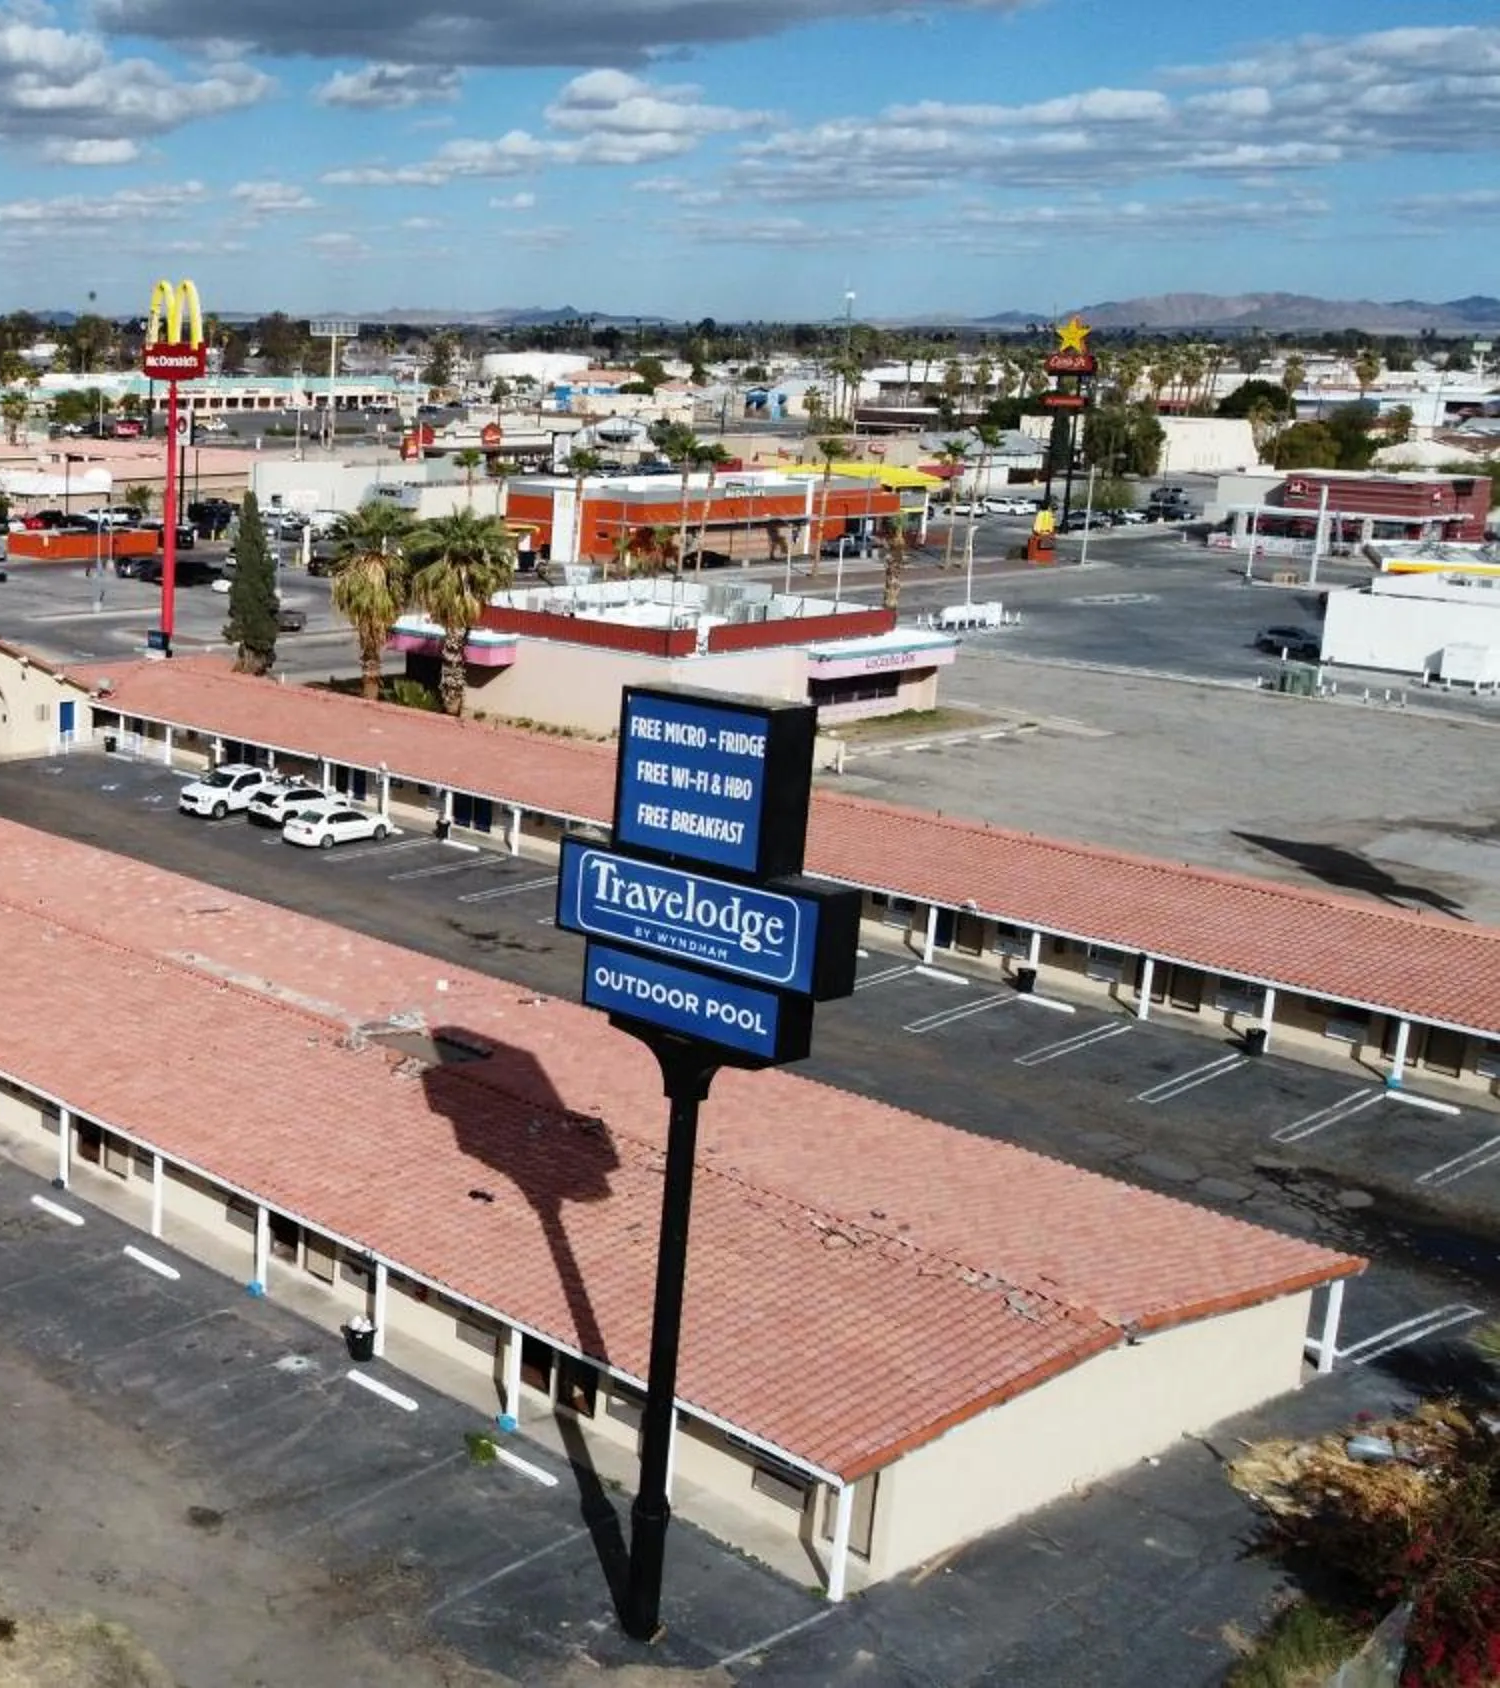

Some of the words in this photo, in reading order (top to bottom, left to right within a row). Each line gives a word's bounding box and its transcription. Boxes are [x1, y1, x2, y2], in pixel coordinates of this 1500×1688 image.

[630, 715, 663, 741] FREE
[664, 722, 707, 749] MICRO
[718, 730, 766, 758] FRIDGE
[637, 760, 669, 786] FREE
[671, 765, 709, 793] WI-FI
[711, 773, 721, 795] &
[723, 776, 753, 800] HBO
[637, 803, 669, 830] FREE
[670, 809, 745, 845] BREAKFAST
[591, 858, 785, 953] Travelodge
[634, 926, 651, 938] BY
[657, 931, 728, 960] WYNDHAM
[595, 967, 699, 1015] OUTDOOR
[705, 999, 768, 1035] POOL
